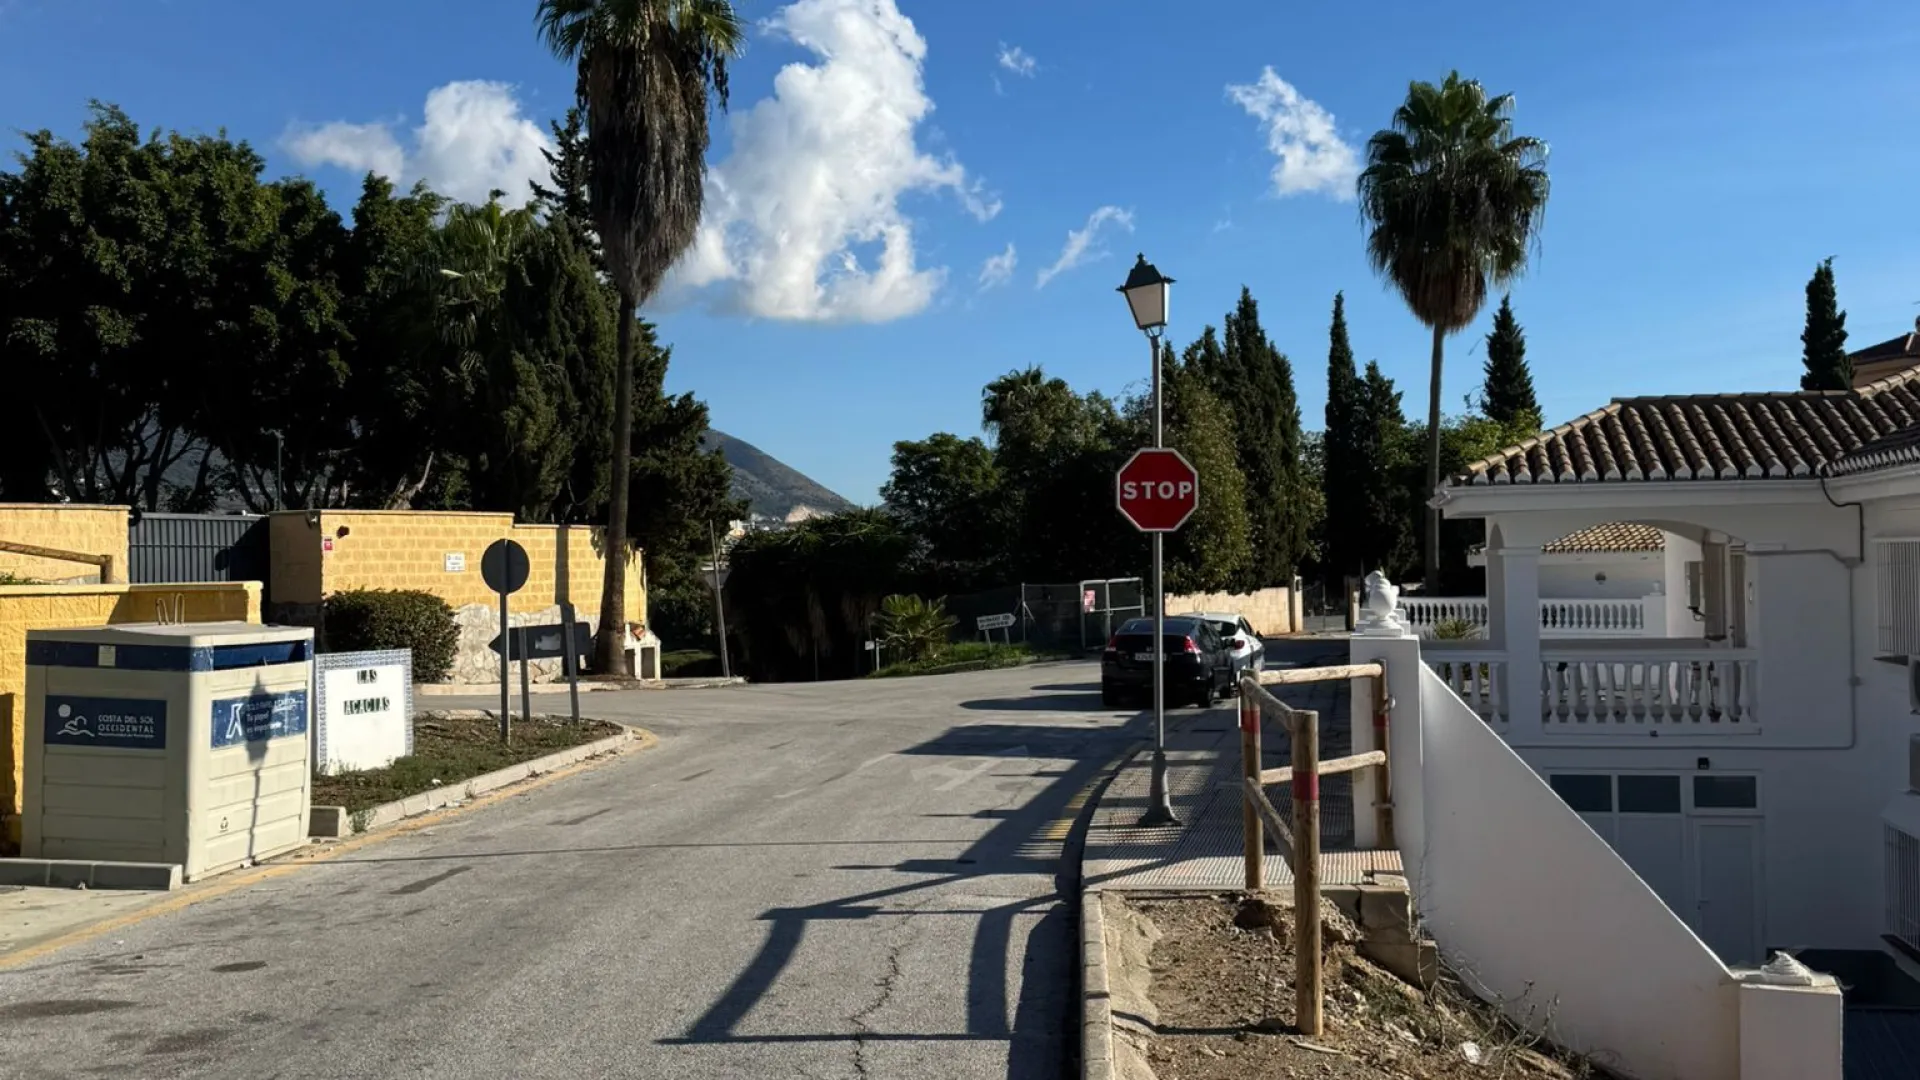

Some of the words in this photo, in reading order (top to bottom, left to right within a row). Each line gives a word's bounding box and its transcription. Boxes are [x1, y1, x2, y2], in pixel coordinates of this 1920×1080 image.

[1122, 481, 1192, 500] STOP
[357, 669, 377, 684] LAS
[344, 697, 390, 715] ACACIAS
[98, 714, 122, 723] COSTA
[124, 715, 138, 724] DEL
[139, 715, 154, 725] SOL
[98, 723, 154, 734] OCCIDENTAL
